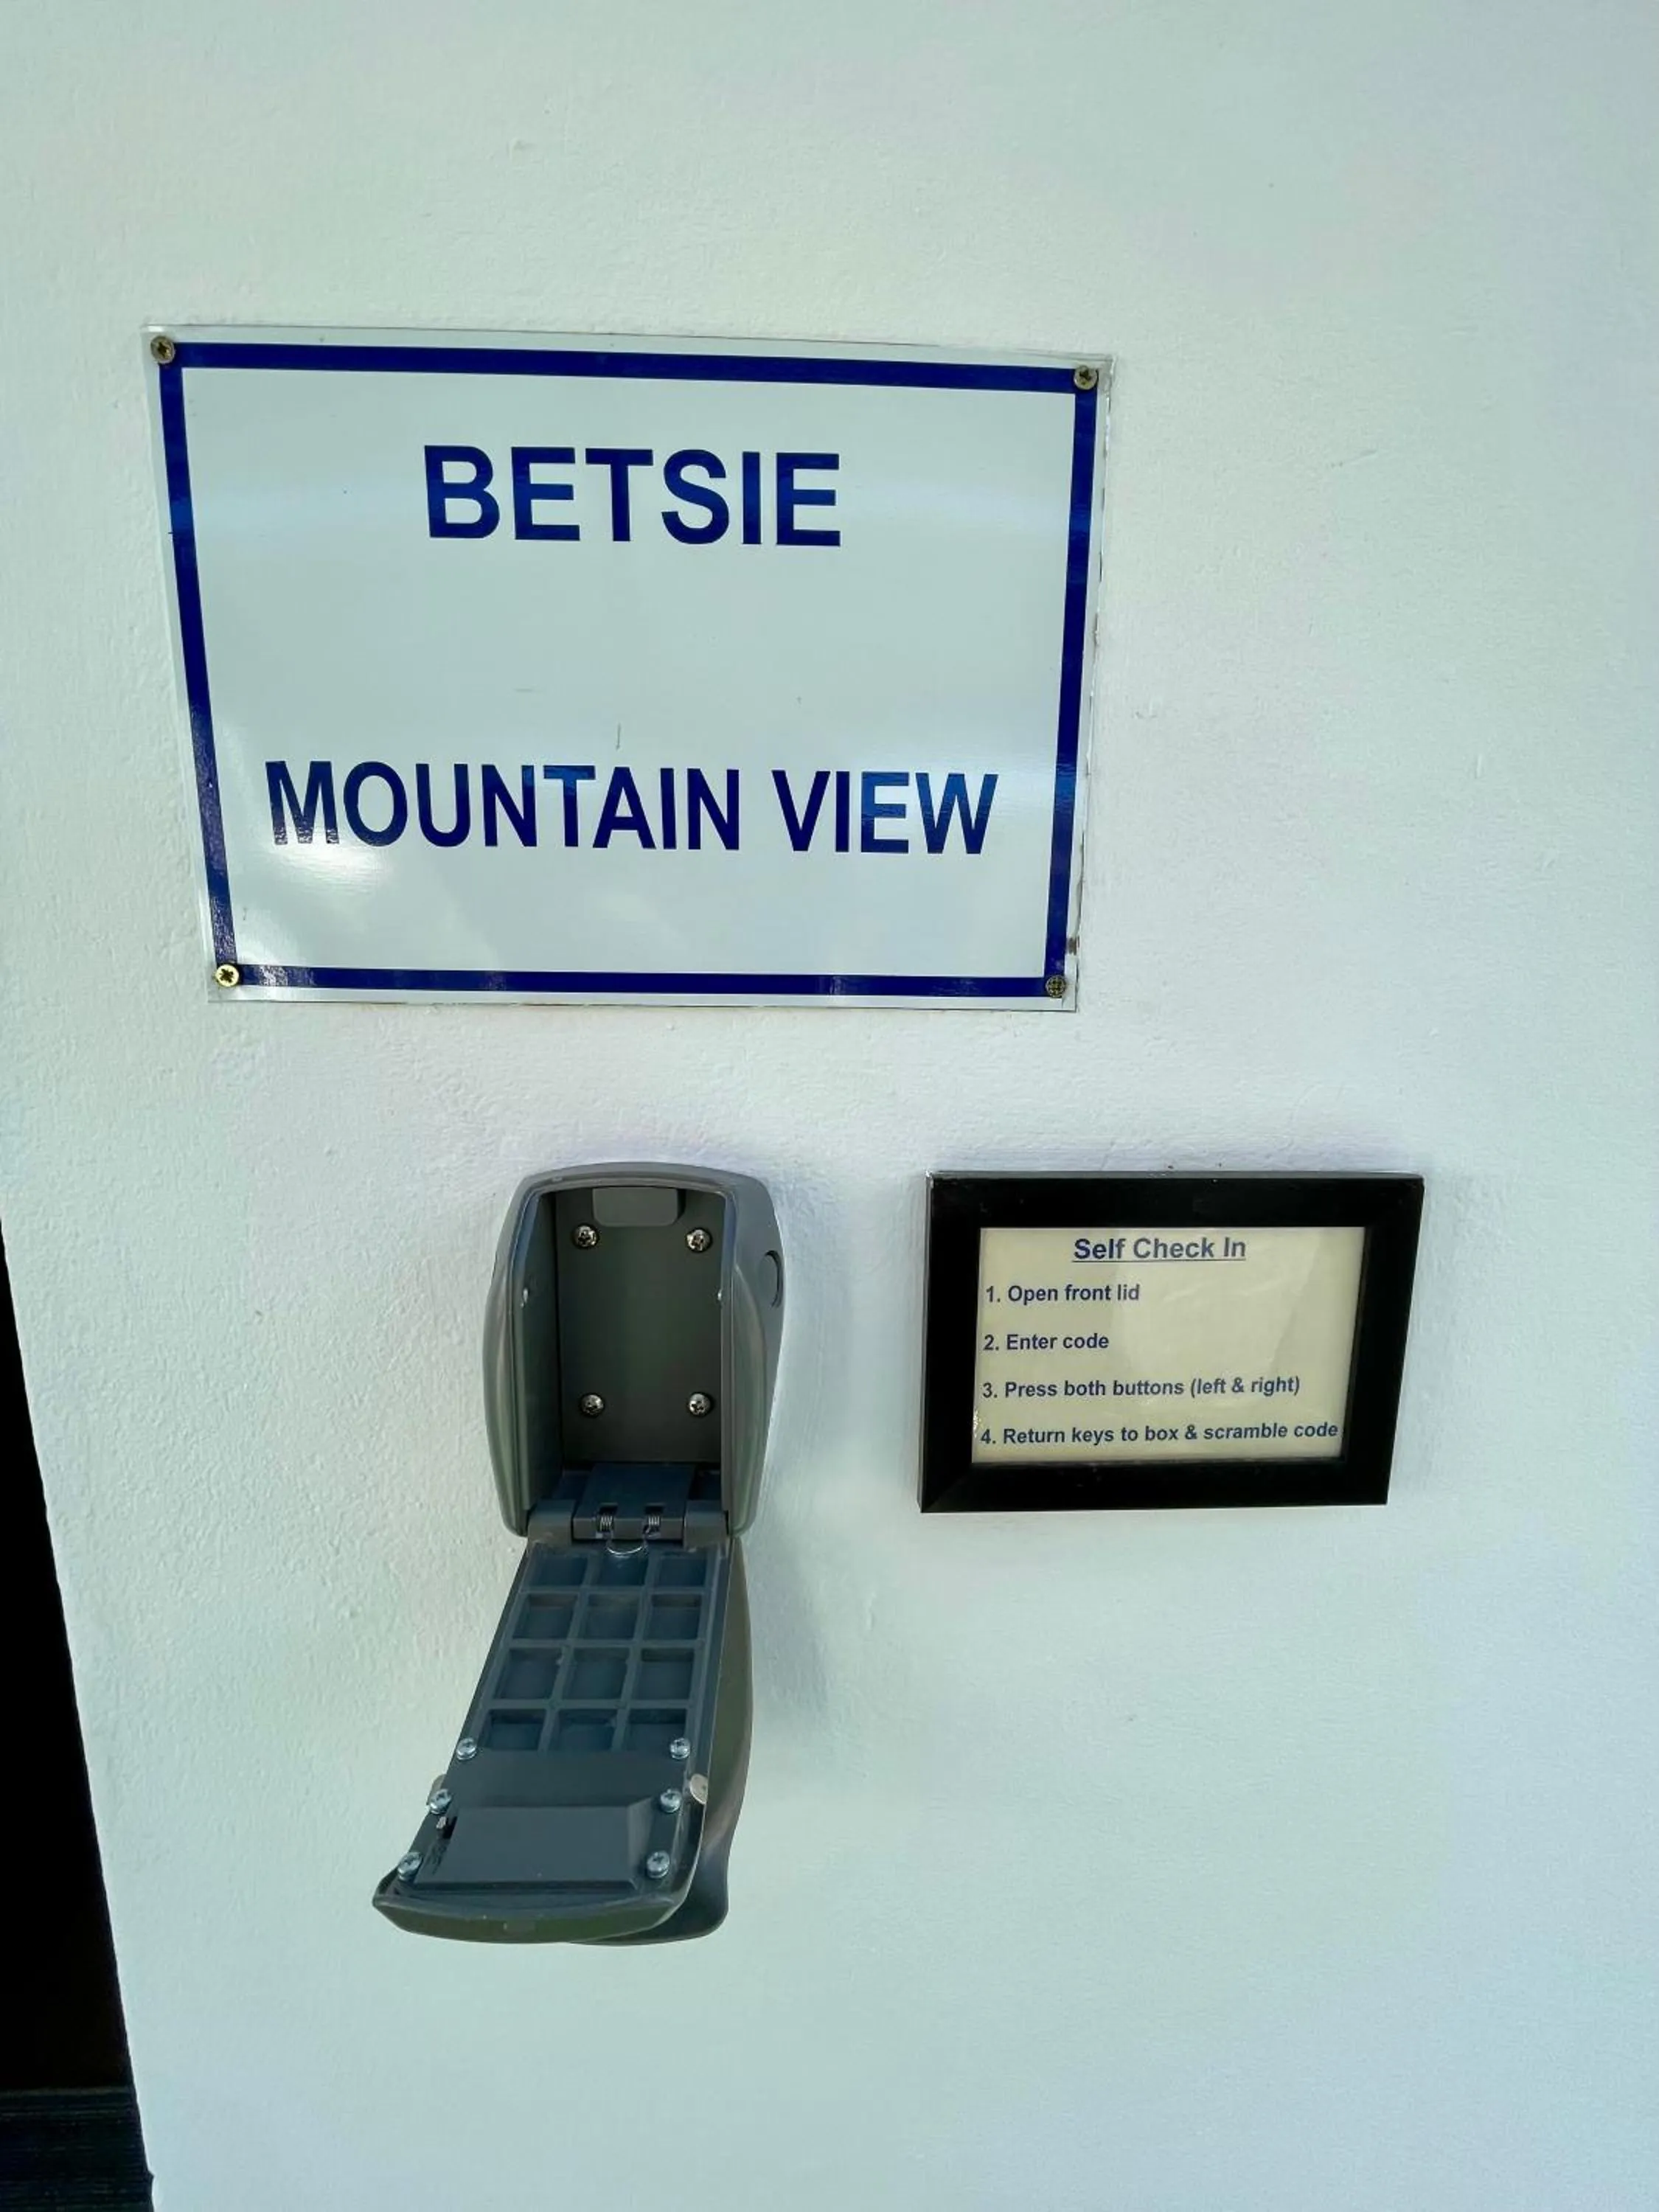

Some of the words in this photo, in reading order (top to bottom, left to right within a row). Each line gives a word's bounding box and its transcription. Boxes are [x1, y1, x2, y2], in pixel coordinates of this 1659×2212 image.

[423, 445, 843, 548] BETSIE
[263, 759, 740, 852] MOUNTAIN
[771, 769, 999, 855] VIEW
[1073, 1237, 1125, 1260] Self
[1133, 1237, 1214, 1259] Check
[1223, 1237, 1247, 1258] In
[985, 1286, 1001, 1304] 1.
[1007, 1285, 1059, 1305] Open
[1064, 1284, 1112, 1301] front
[1116, 1284, 1141, 1301] lid
[983, 1335, 1000, 1352] 2.
[1006, 1334, 1058, 1351] Enter
[1062, 1332, 1110, 1349] code
[982, 1382, 998, 1399] 3.
[1004, 1381, 1058, 1398] Press
[1063, 1380, 1106, 1397] both
[1112, 1380, 1184, 1397] buttons
[1189, 1378, 1226, 1399] (left
[1231, 1378, 1245, 1394] &
[1250, 1377, 1301, 1398] right)
[981, 1429, 997, 1444] 4.
[1002, 1427, 1066, 1444] Return
[1071, 1427, 1115, 1447] keys
[1120, 1426, 1139, 1443] to
[1144, 1425, 1179, 1442] box
[1183, 1425, 1198, 1441] &
[1203, 1423, 1288, 1441] scramble
[1293, 1422, 1338, 1439] code
